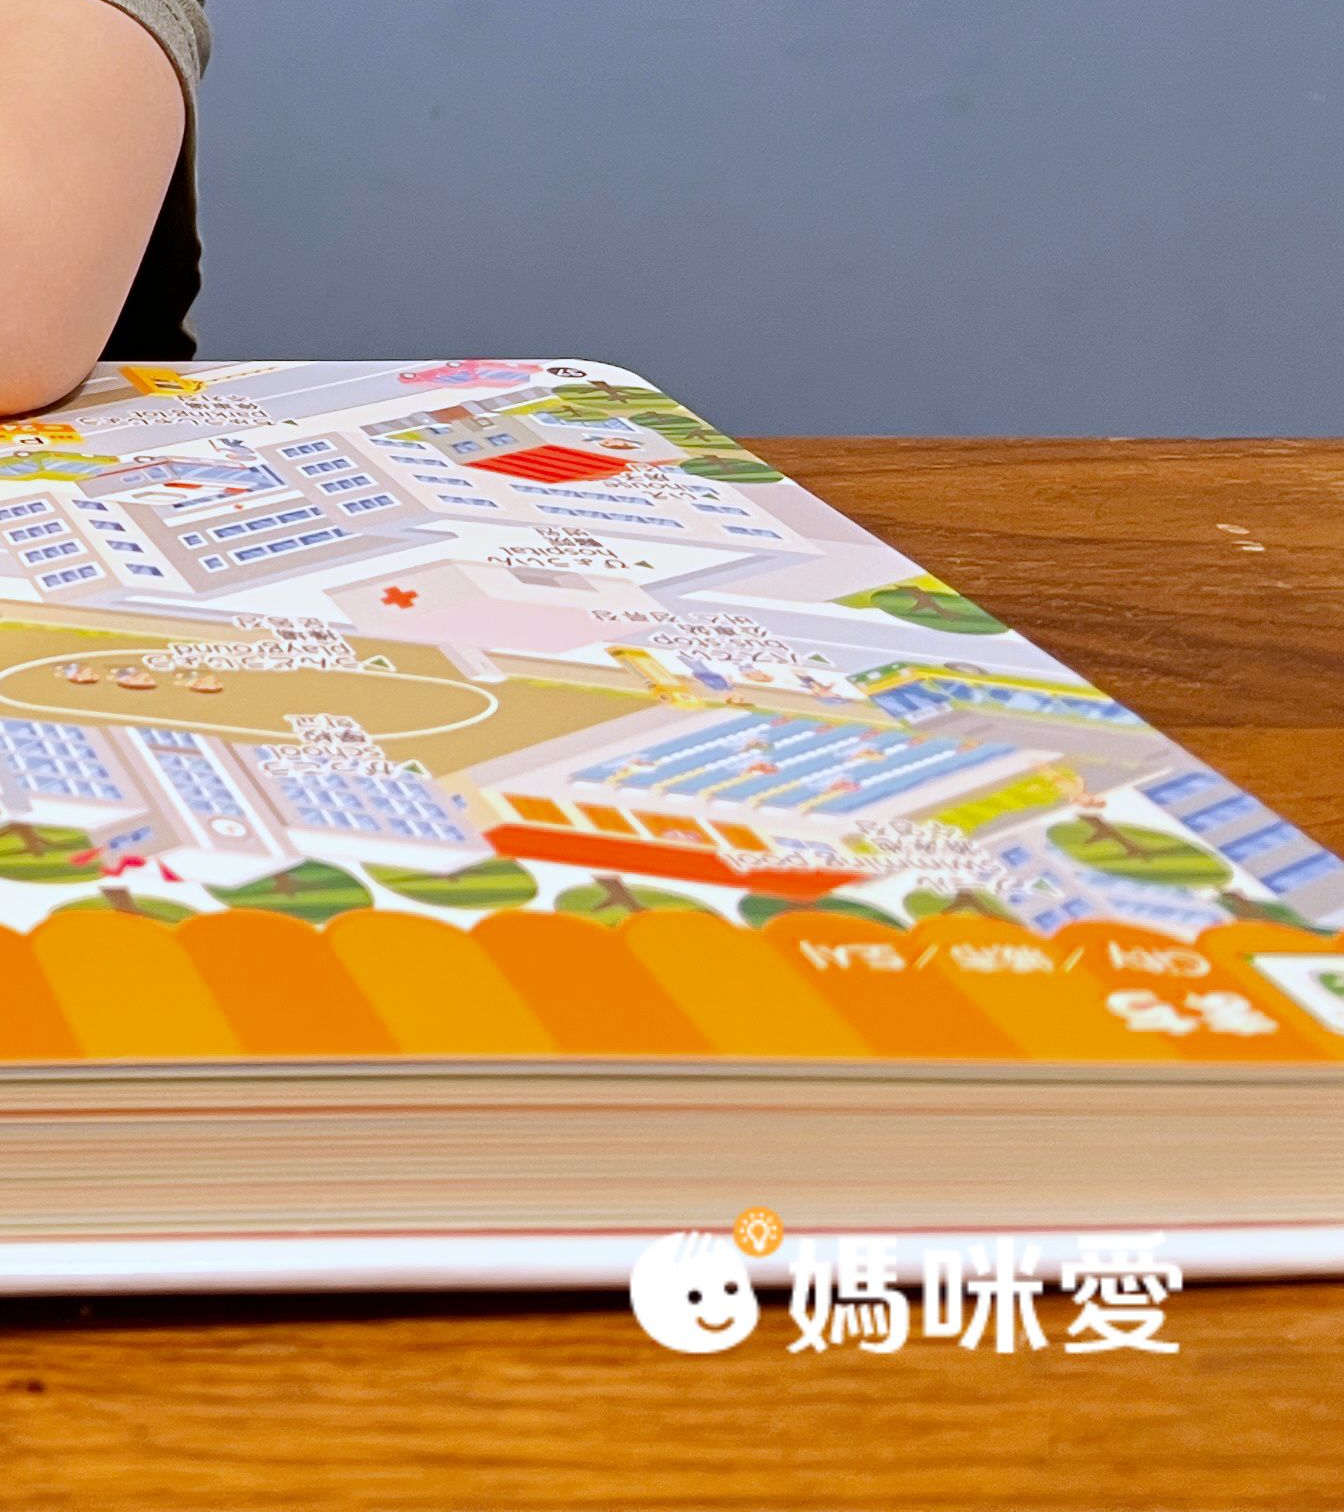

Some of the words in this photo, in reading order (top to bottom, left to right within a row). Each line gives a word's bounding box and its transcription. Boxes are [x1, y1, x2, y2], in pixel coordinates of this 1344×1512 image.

[129, 410, 168, 419] lot
[176, 408, 268, 420] parking
[603, 481, 688, 491] house
[500, 546, 618, 558] hospital
[172, 641, 352, 656] playground
[652, 633, 716, 650] stop
[729, 638, 785, 649] bus
[270, 745, 381, 760] school
[723, 850, 806, 869] pool
[815, 852, 1000, 872] swimming
[1109, 941, 1212, 978] City
